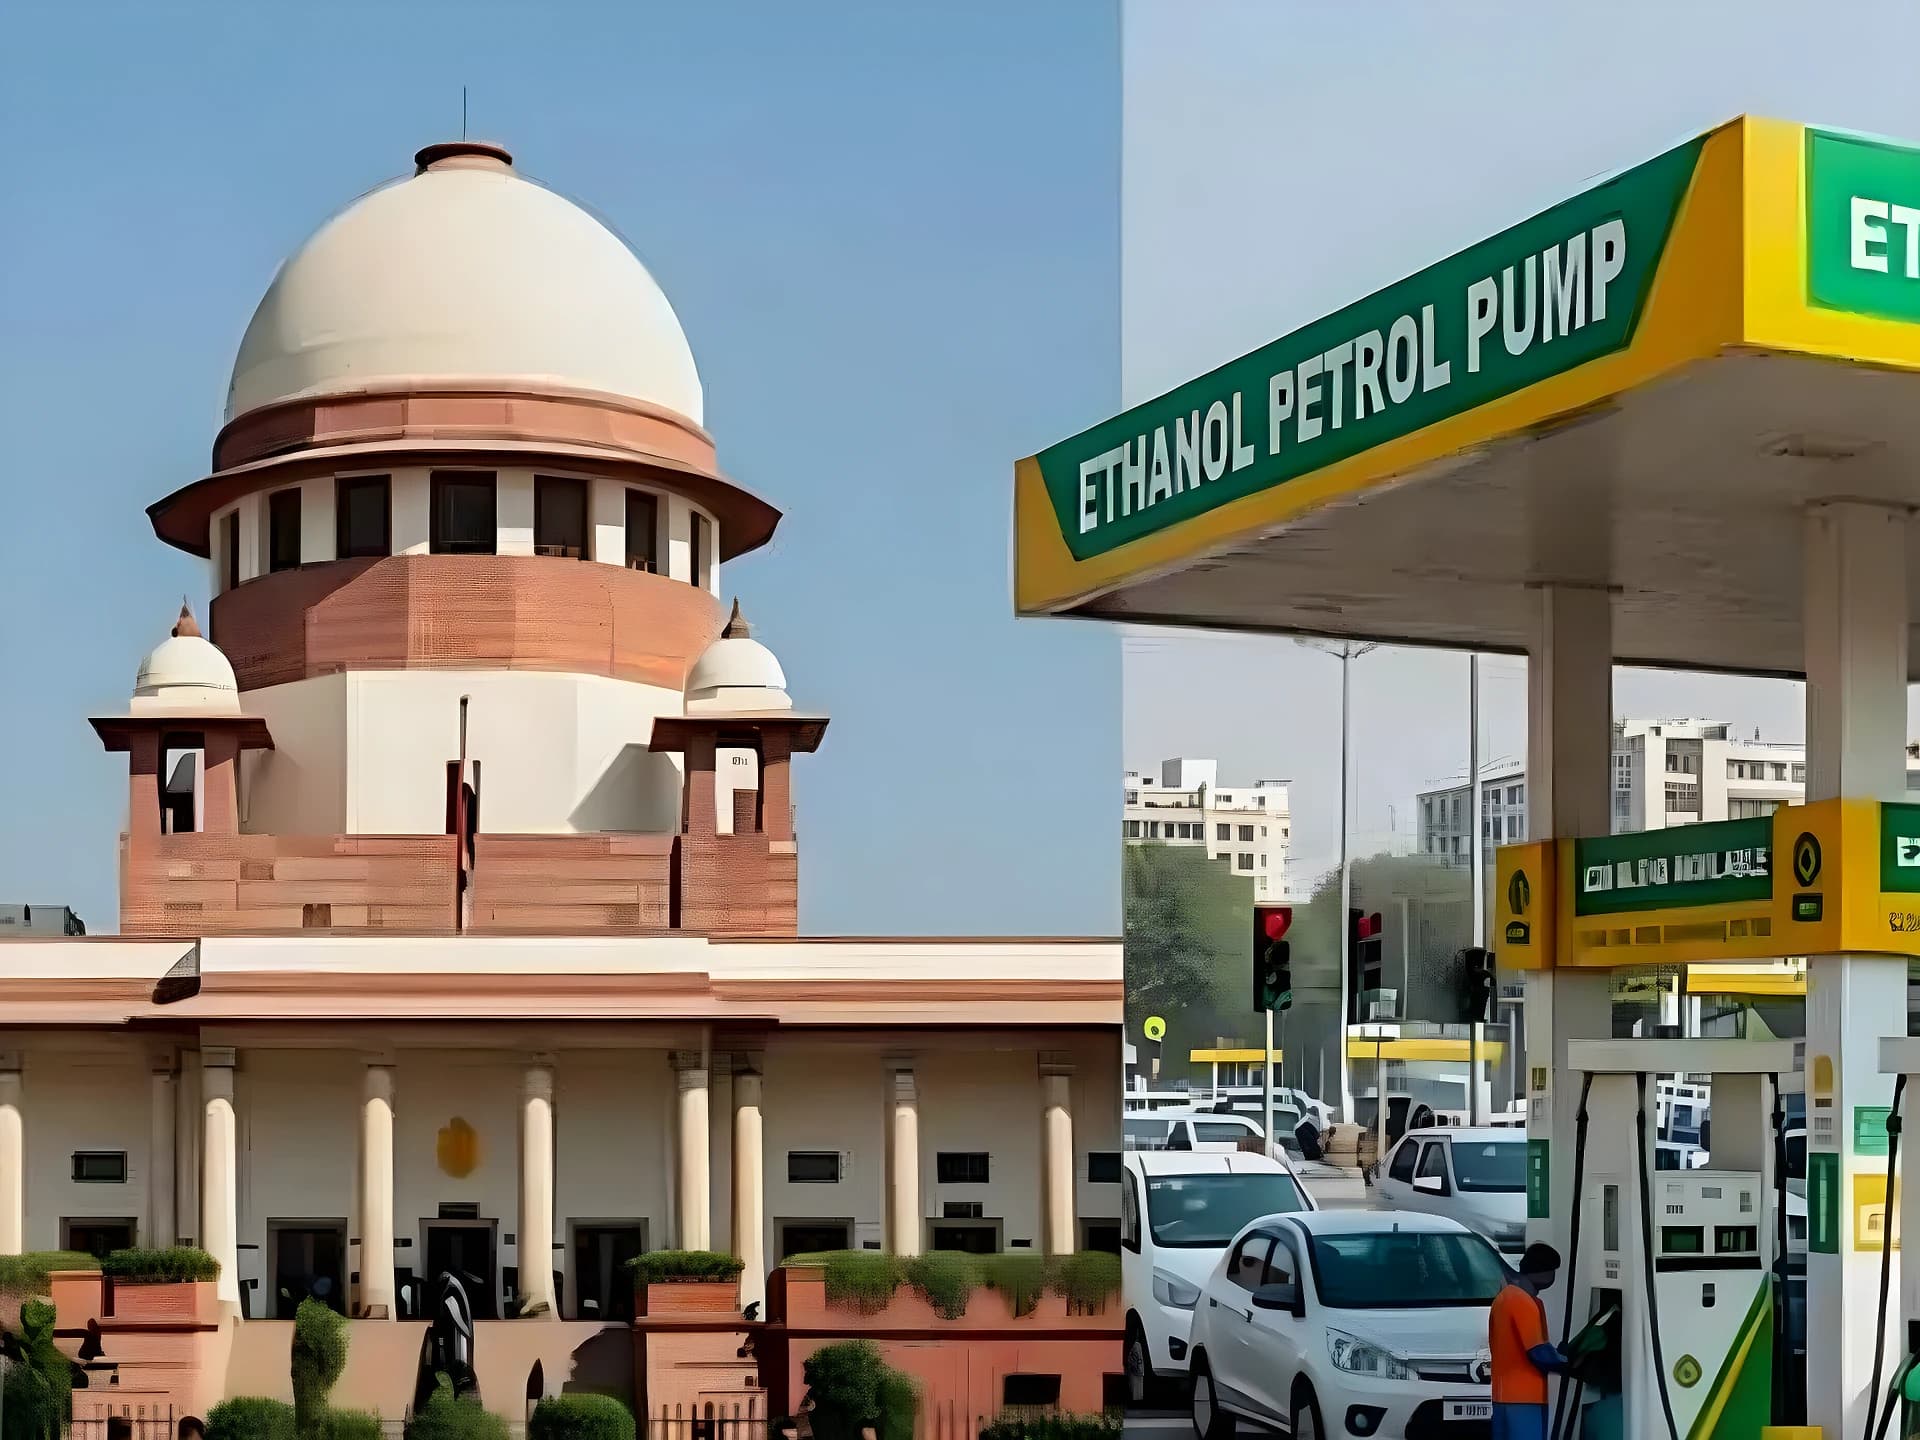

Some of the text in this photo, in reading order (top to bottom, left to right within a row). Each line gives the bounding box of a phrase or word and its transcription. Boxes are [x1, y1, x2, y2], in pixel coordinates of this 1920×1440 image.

[1079, 219, 1626, 534] ETHANOL PETROL PUMP
